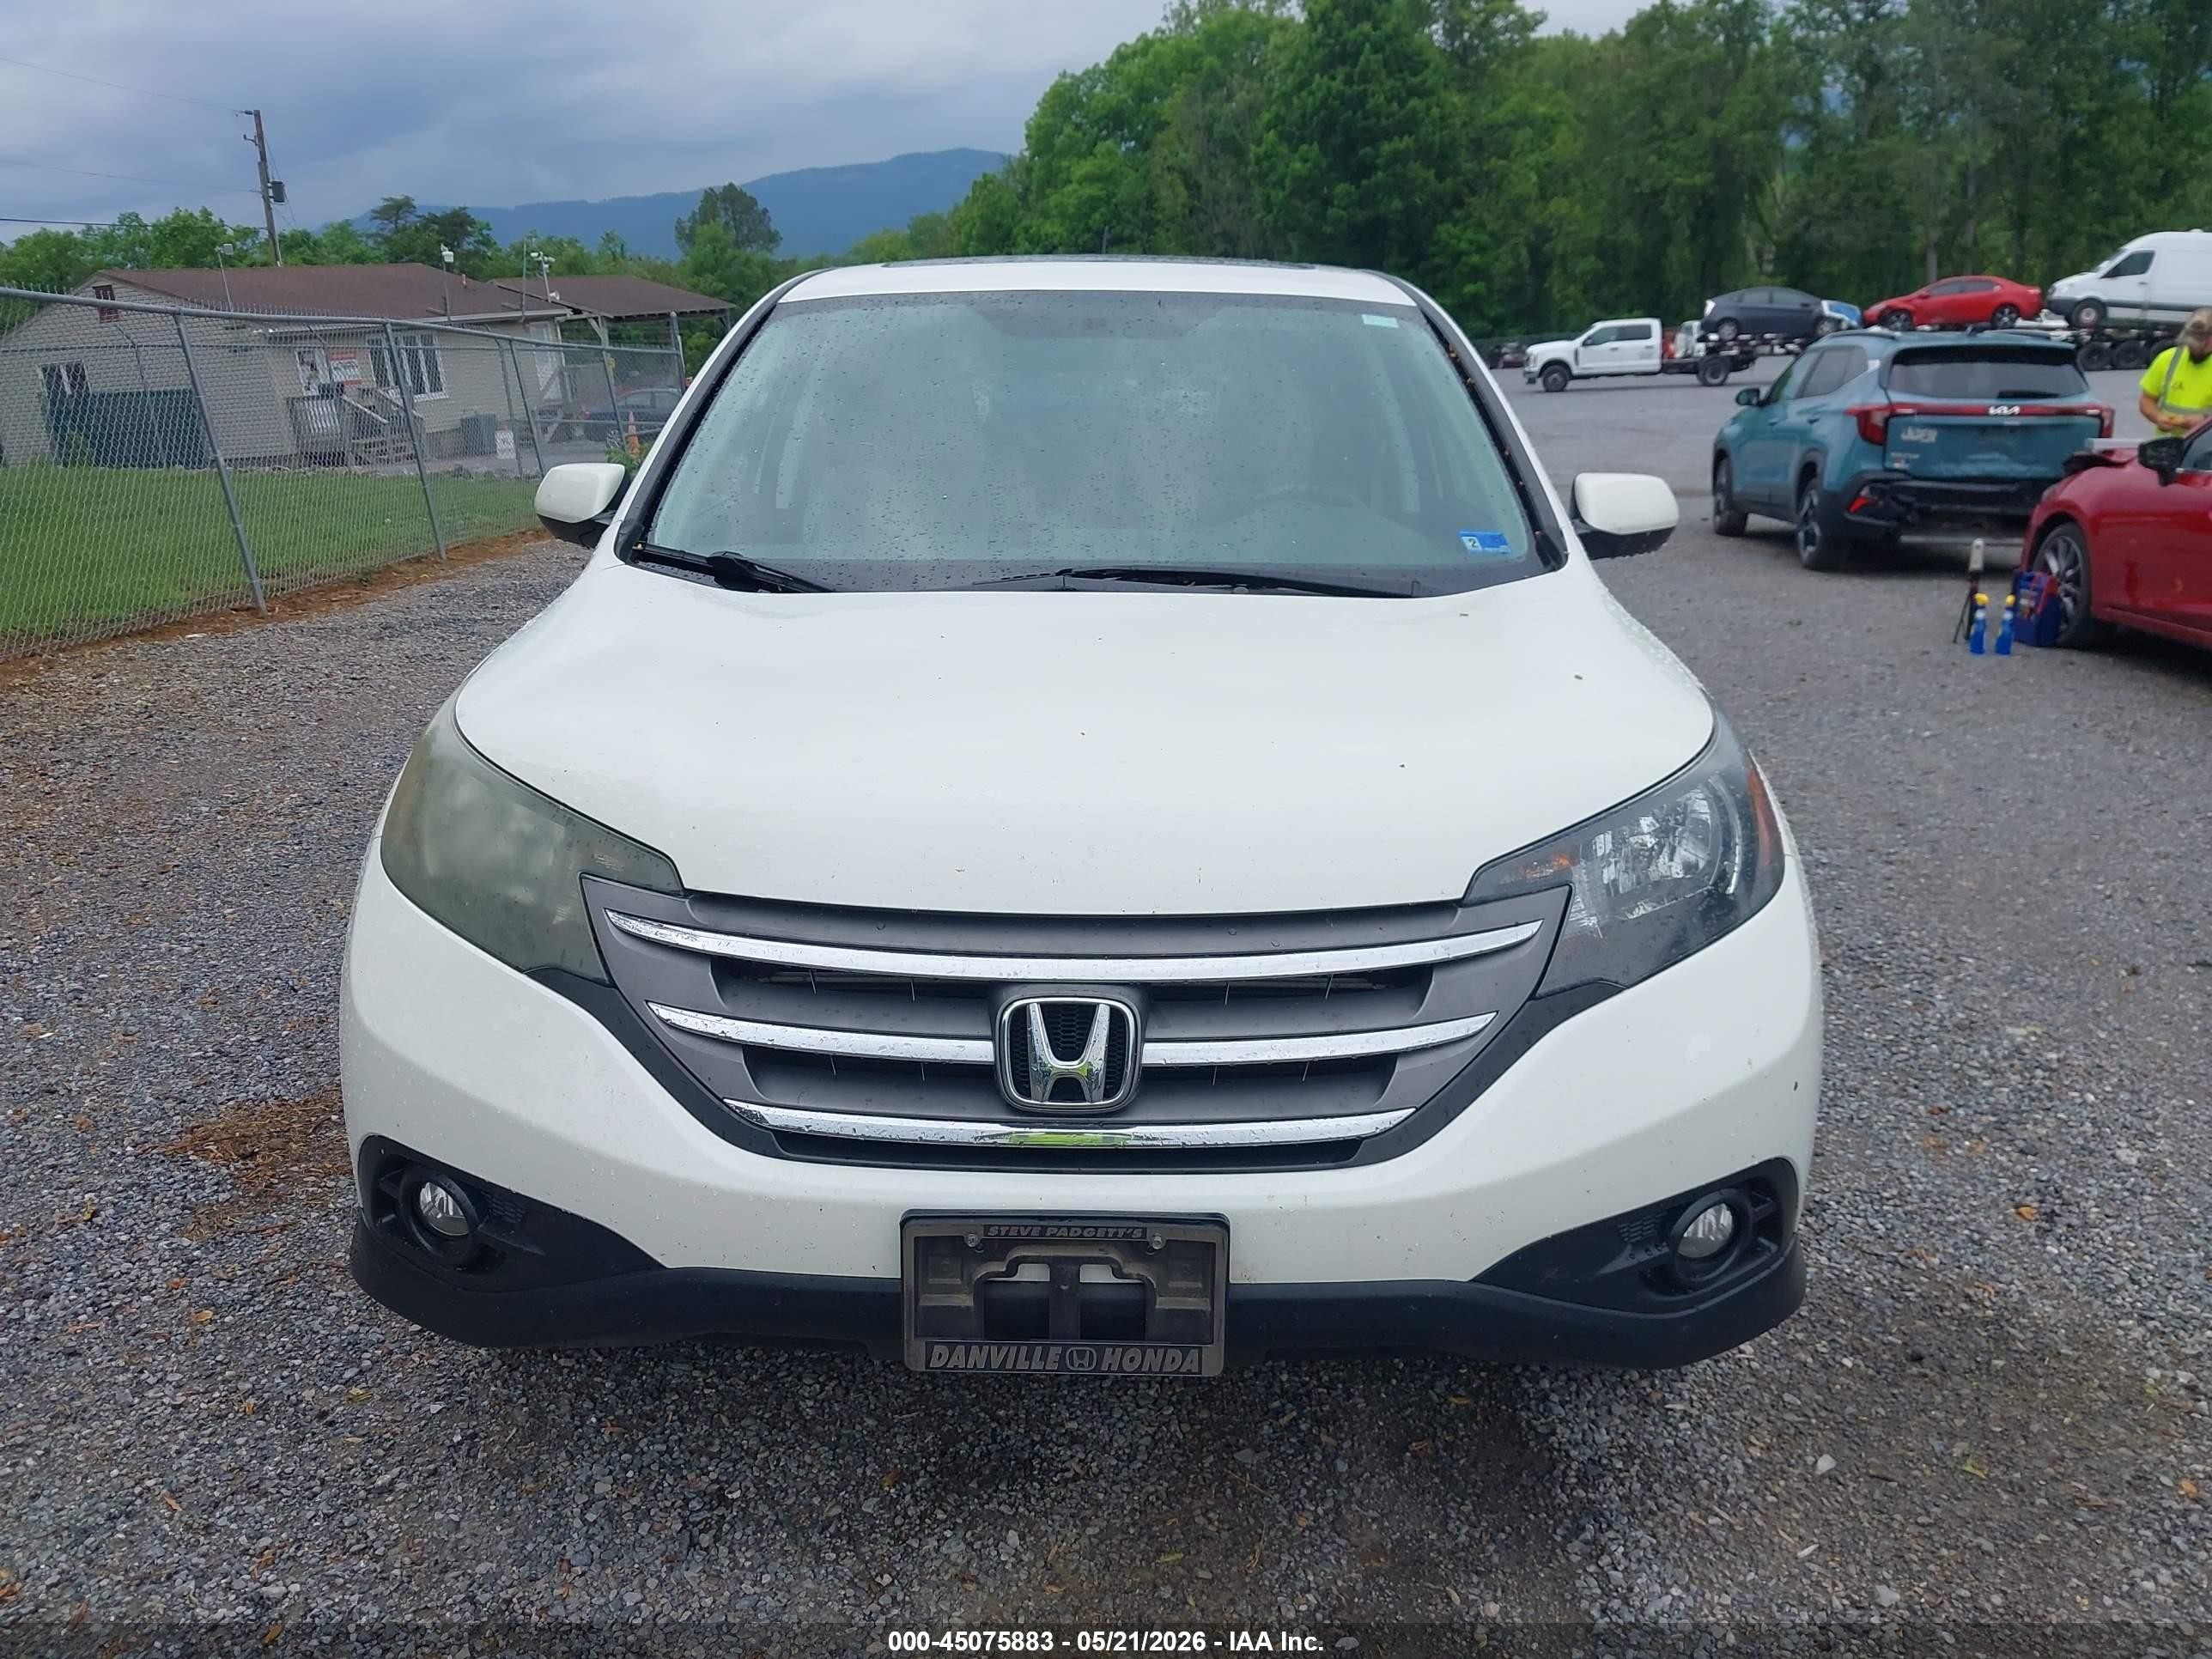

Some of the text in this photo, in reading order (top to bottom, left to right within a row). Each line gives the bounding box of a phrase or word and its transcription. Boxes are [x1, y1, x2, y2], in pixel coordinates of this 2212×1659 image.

[988, 1226, 1144, 1238] STEVE PADGETT'S
[929, 1345, 1062, 1370] DANVILLE
[1101, 1347, 1200, 1373] HONDA
